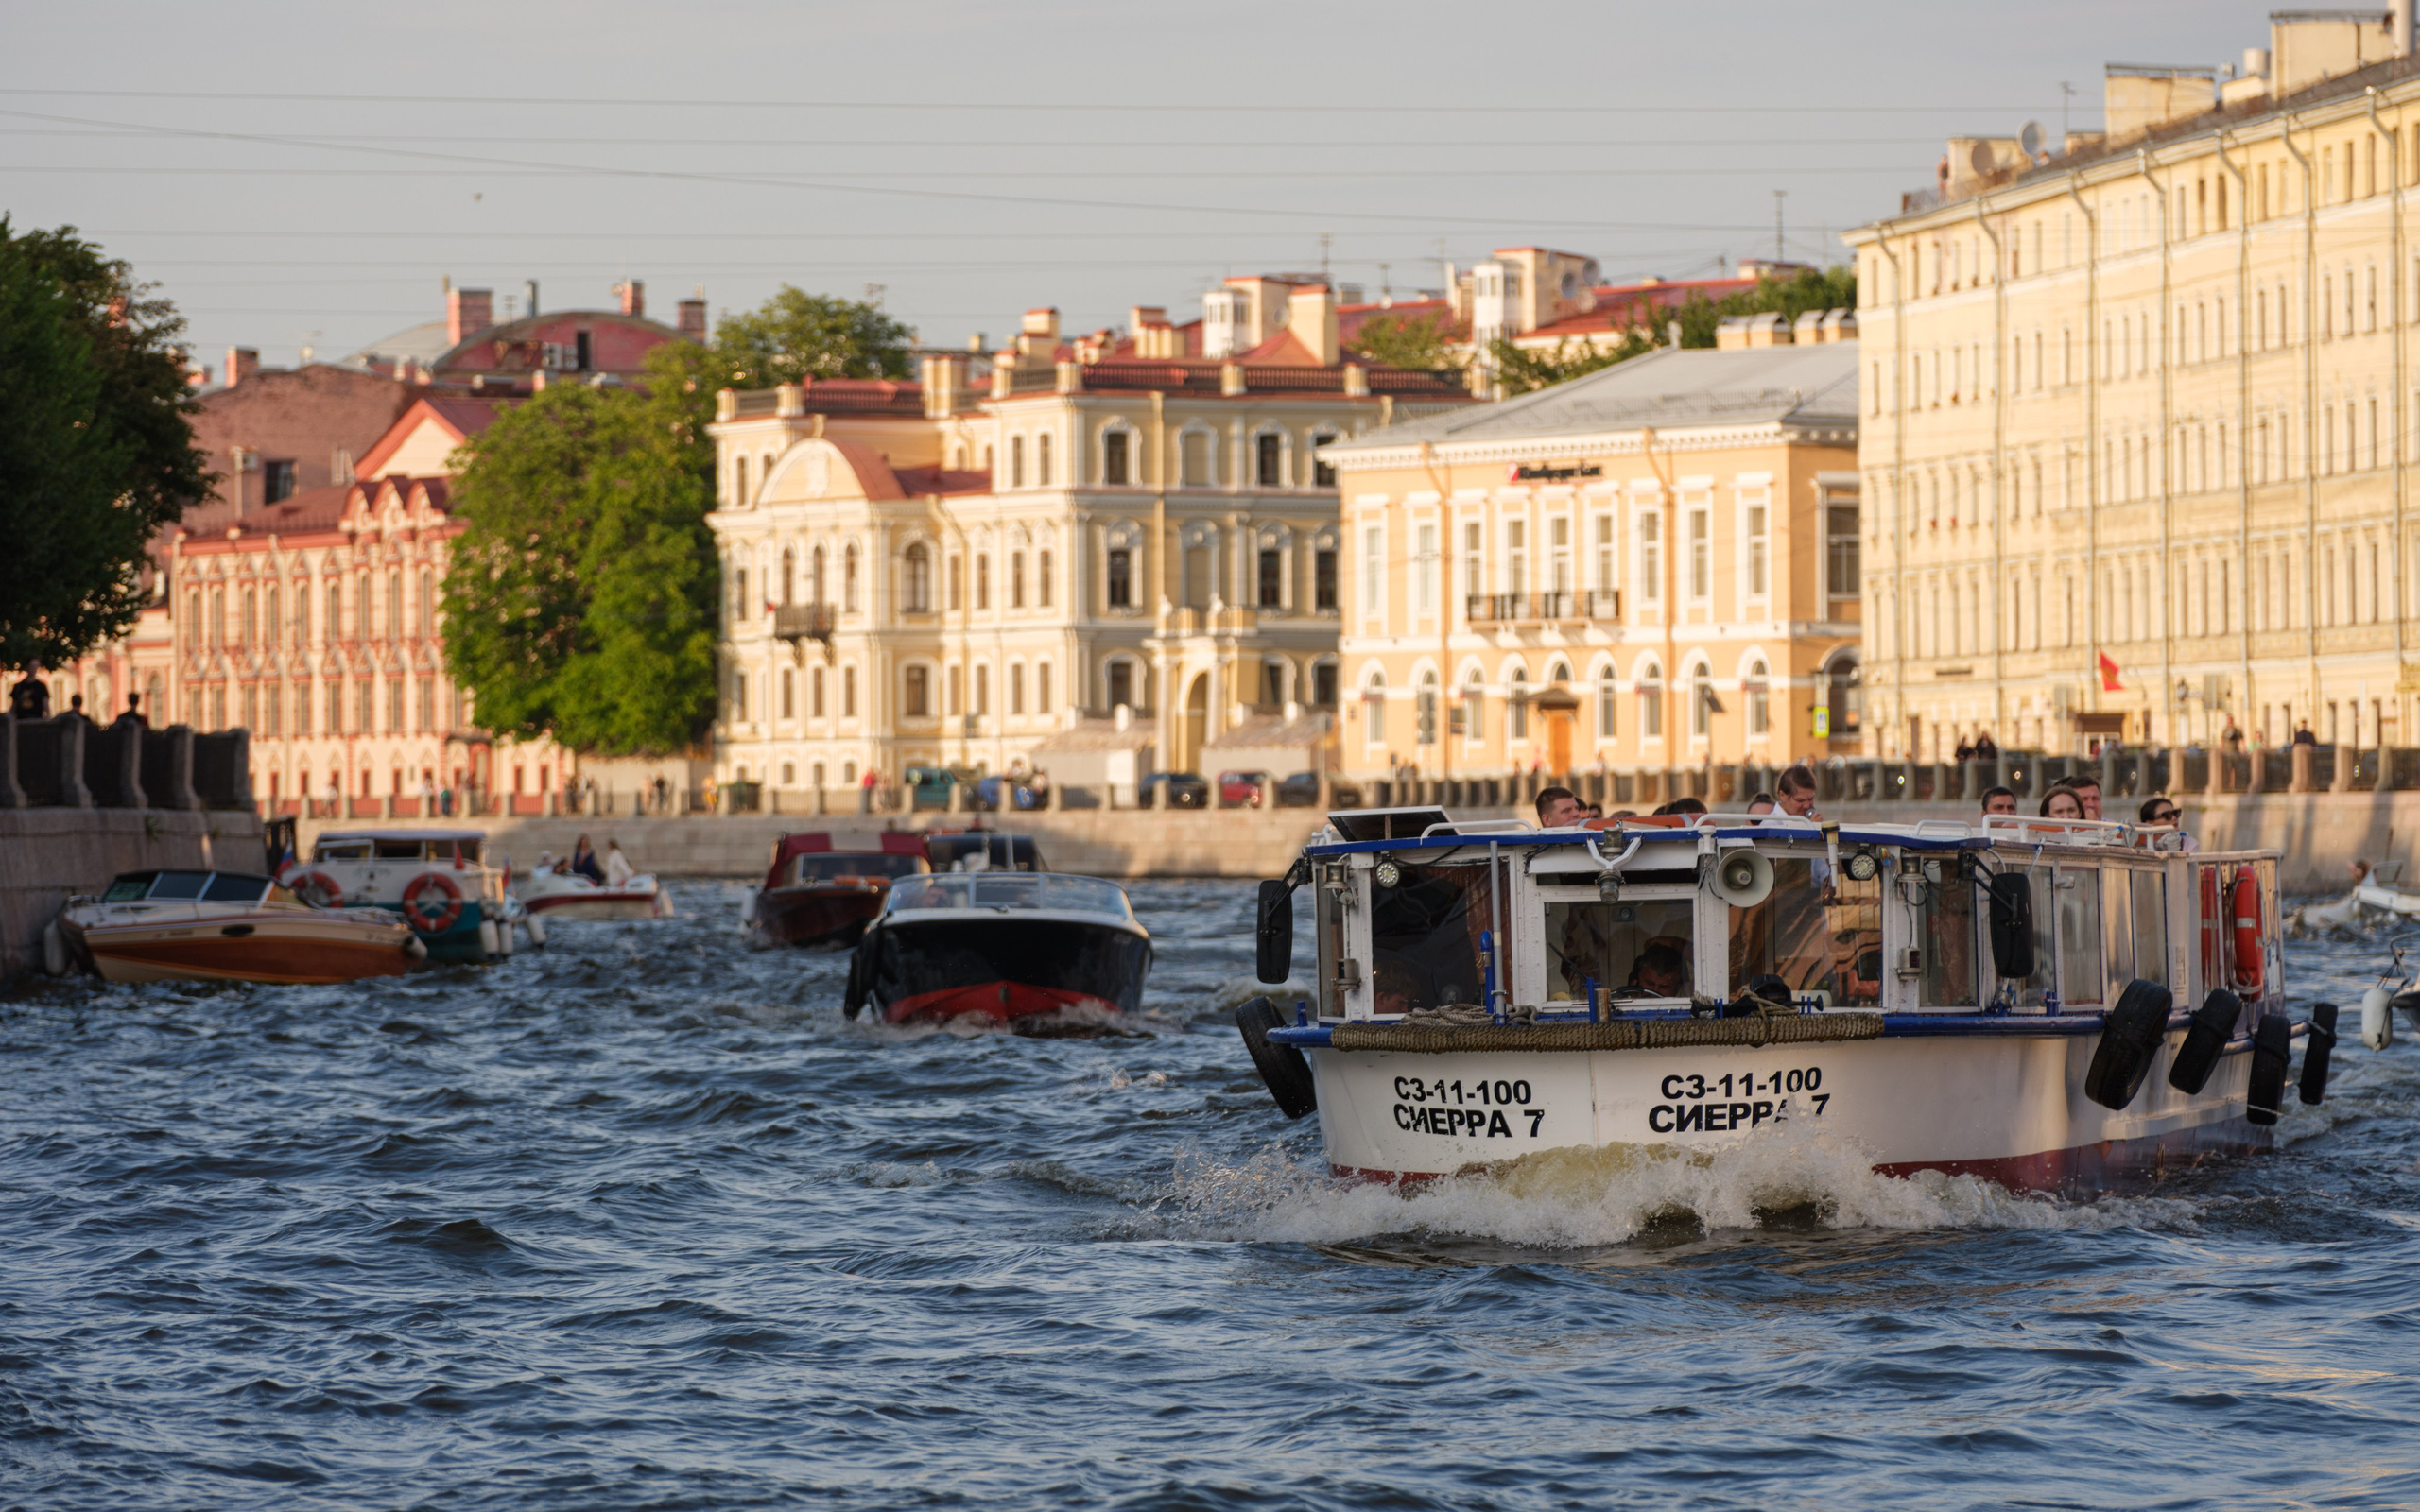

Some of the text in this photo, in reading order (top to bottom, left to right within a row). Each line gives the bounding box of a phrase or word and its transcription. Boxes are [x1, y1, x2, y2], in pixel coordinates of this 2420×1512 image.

[1810, 1092, 1831, 1116] 7
[1392, 1103, 1546, 1138] СИЕРРА 7
